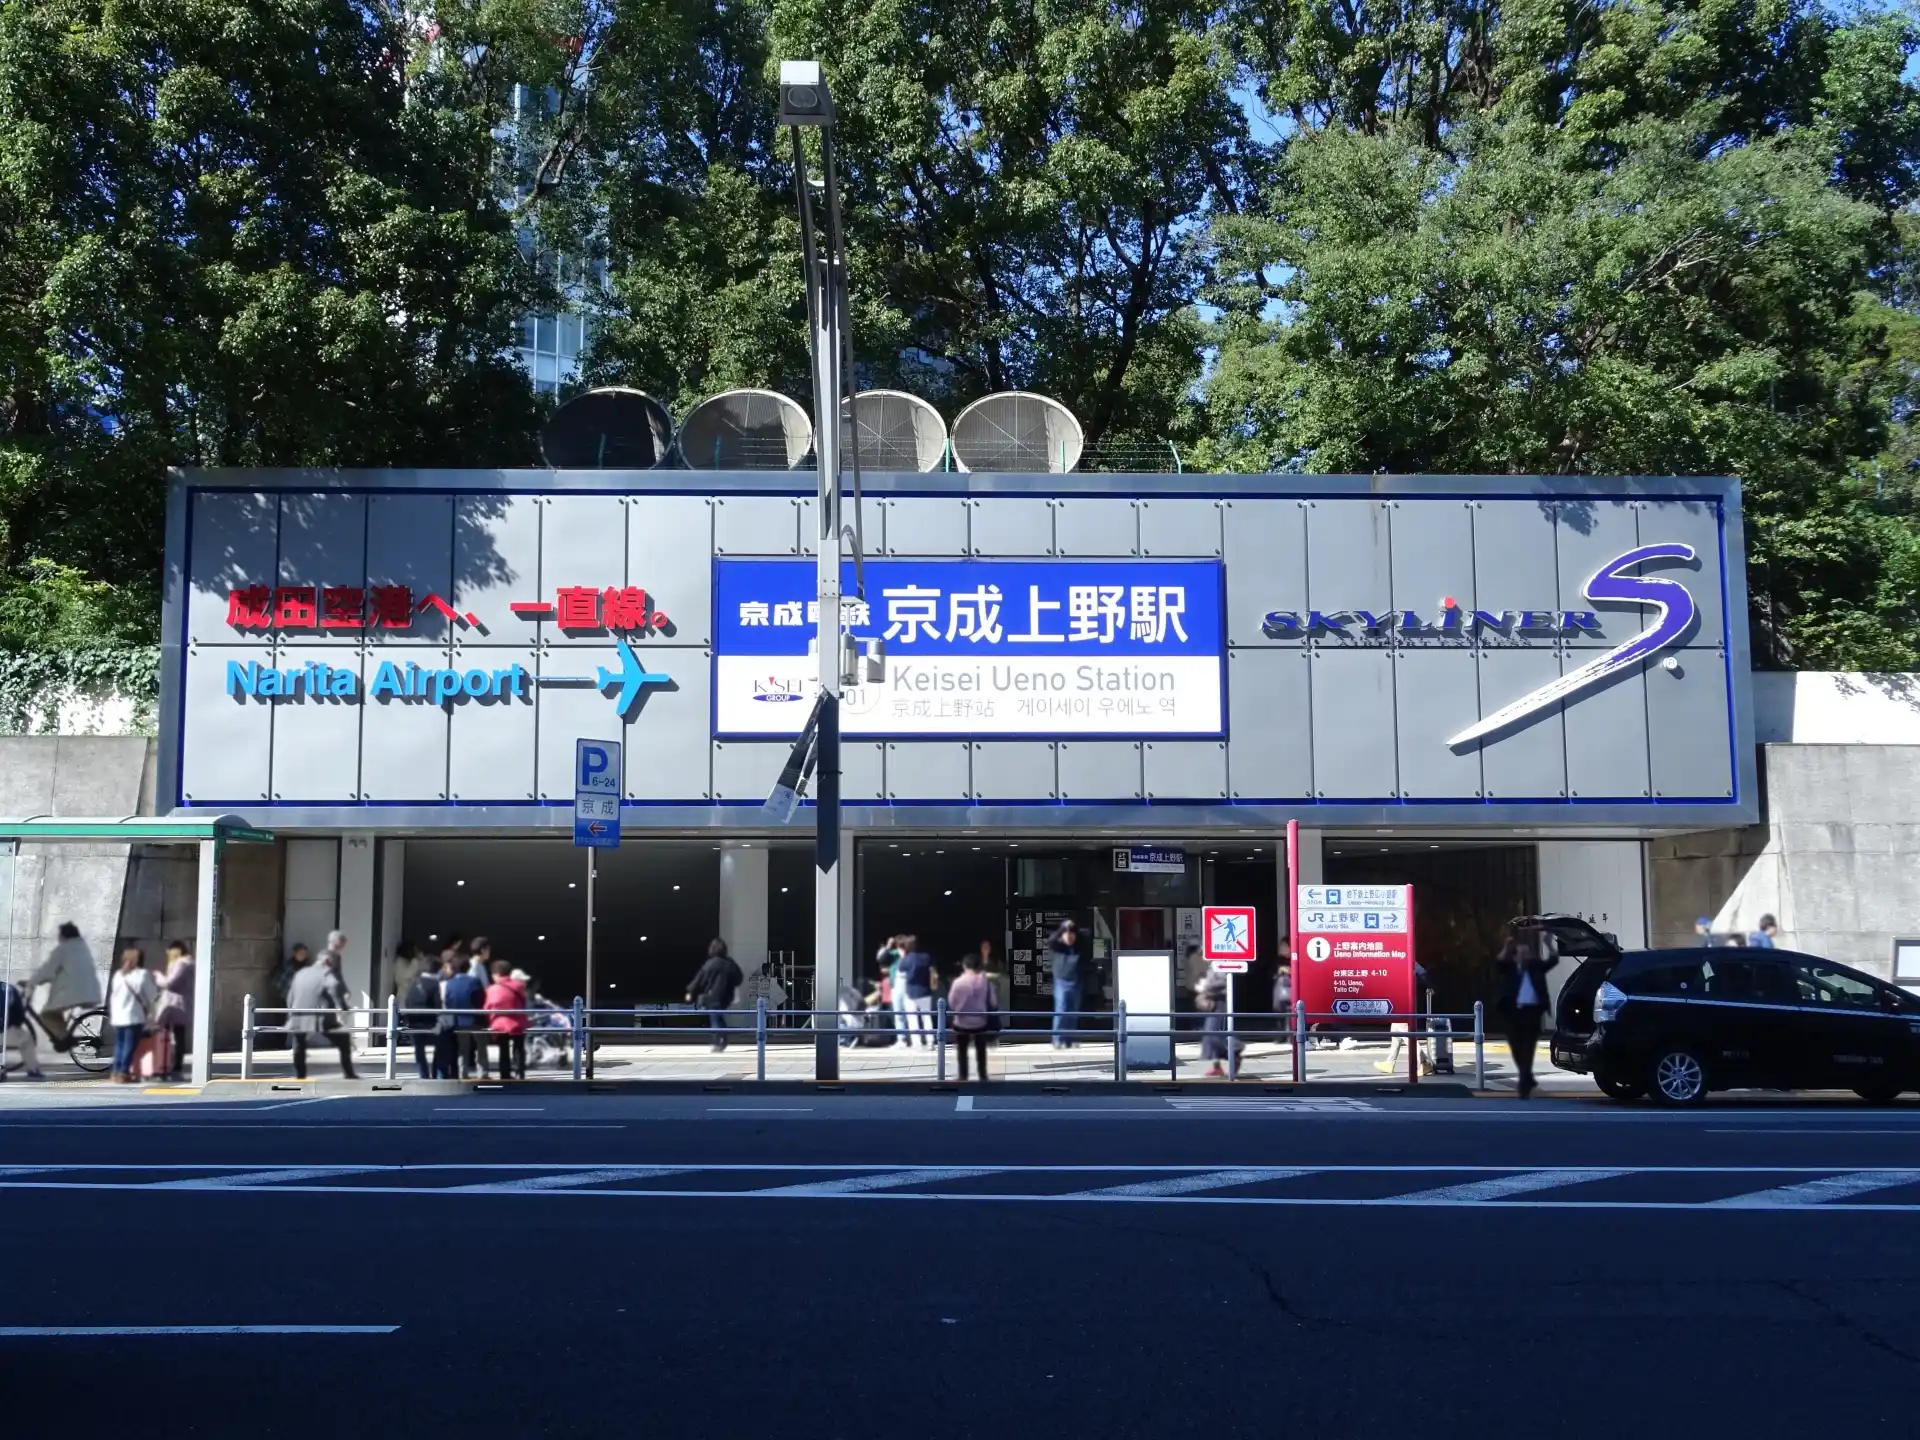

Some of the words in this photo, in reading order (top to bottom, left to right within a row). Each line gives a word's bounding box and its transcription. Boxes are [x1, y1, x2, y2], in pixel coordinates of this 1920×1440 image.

[882, 585, 1189, 643] 京成上野駅
[226, 660, 357, 697] Narita
[369, 660, 525, 705] Airport
[893, 665, 981, 691] Keisei
[992, 665, 1066, 691] Ueno
[1076, 665, 1176, 691] Station
[765, 694, 791, 702] GROUP
[846, 689, 865, 705] 01
[892, 698, 995, 718] 京成上野站
[1017, 697, 1091, 718] 게이세이
[1097, 697, 1152, 718] 우에노
[1159, 697, 1176, 717] 역
[582, 746, 609, 786] P
[592, 776, 616, 788] 6-24
[1308, 913, 1325, 922] JR
[1329, 912, 1361, 923] 上野駅
[1334, 950, 1352, 958] Ueno
[1353, 950, 1390, 958] Information
[1391, 950, 1406, 960] Map
[1371, 969, 1388, 977] 4-10
